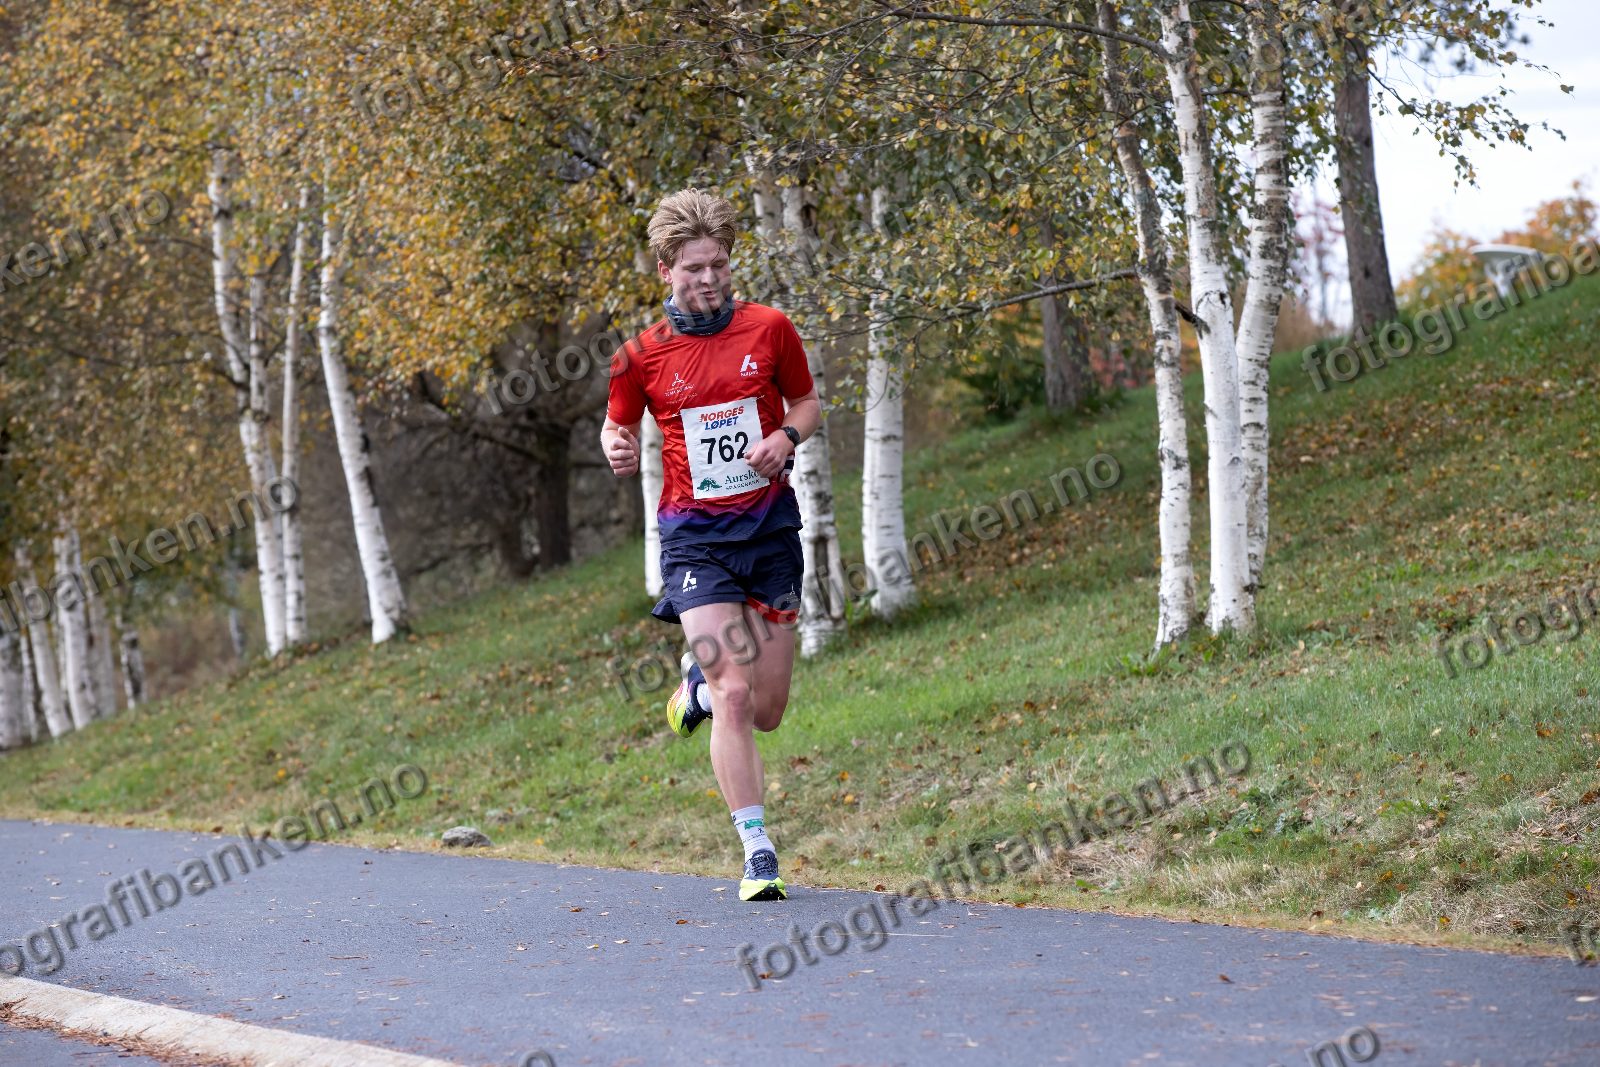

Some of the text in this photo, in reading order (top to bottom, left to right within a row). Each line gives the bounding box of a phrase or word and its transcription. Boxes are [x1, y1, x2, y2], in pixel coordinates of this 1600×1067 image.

[699, 406, 744, 422] NORGES
[705, 416, 739, 430] LØPET
[700, 431, 749, 465] 762
